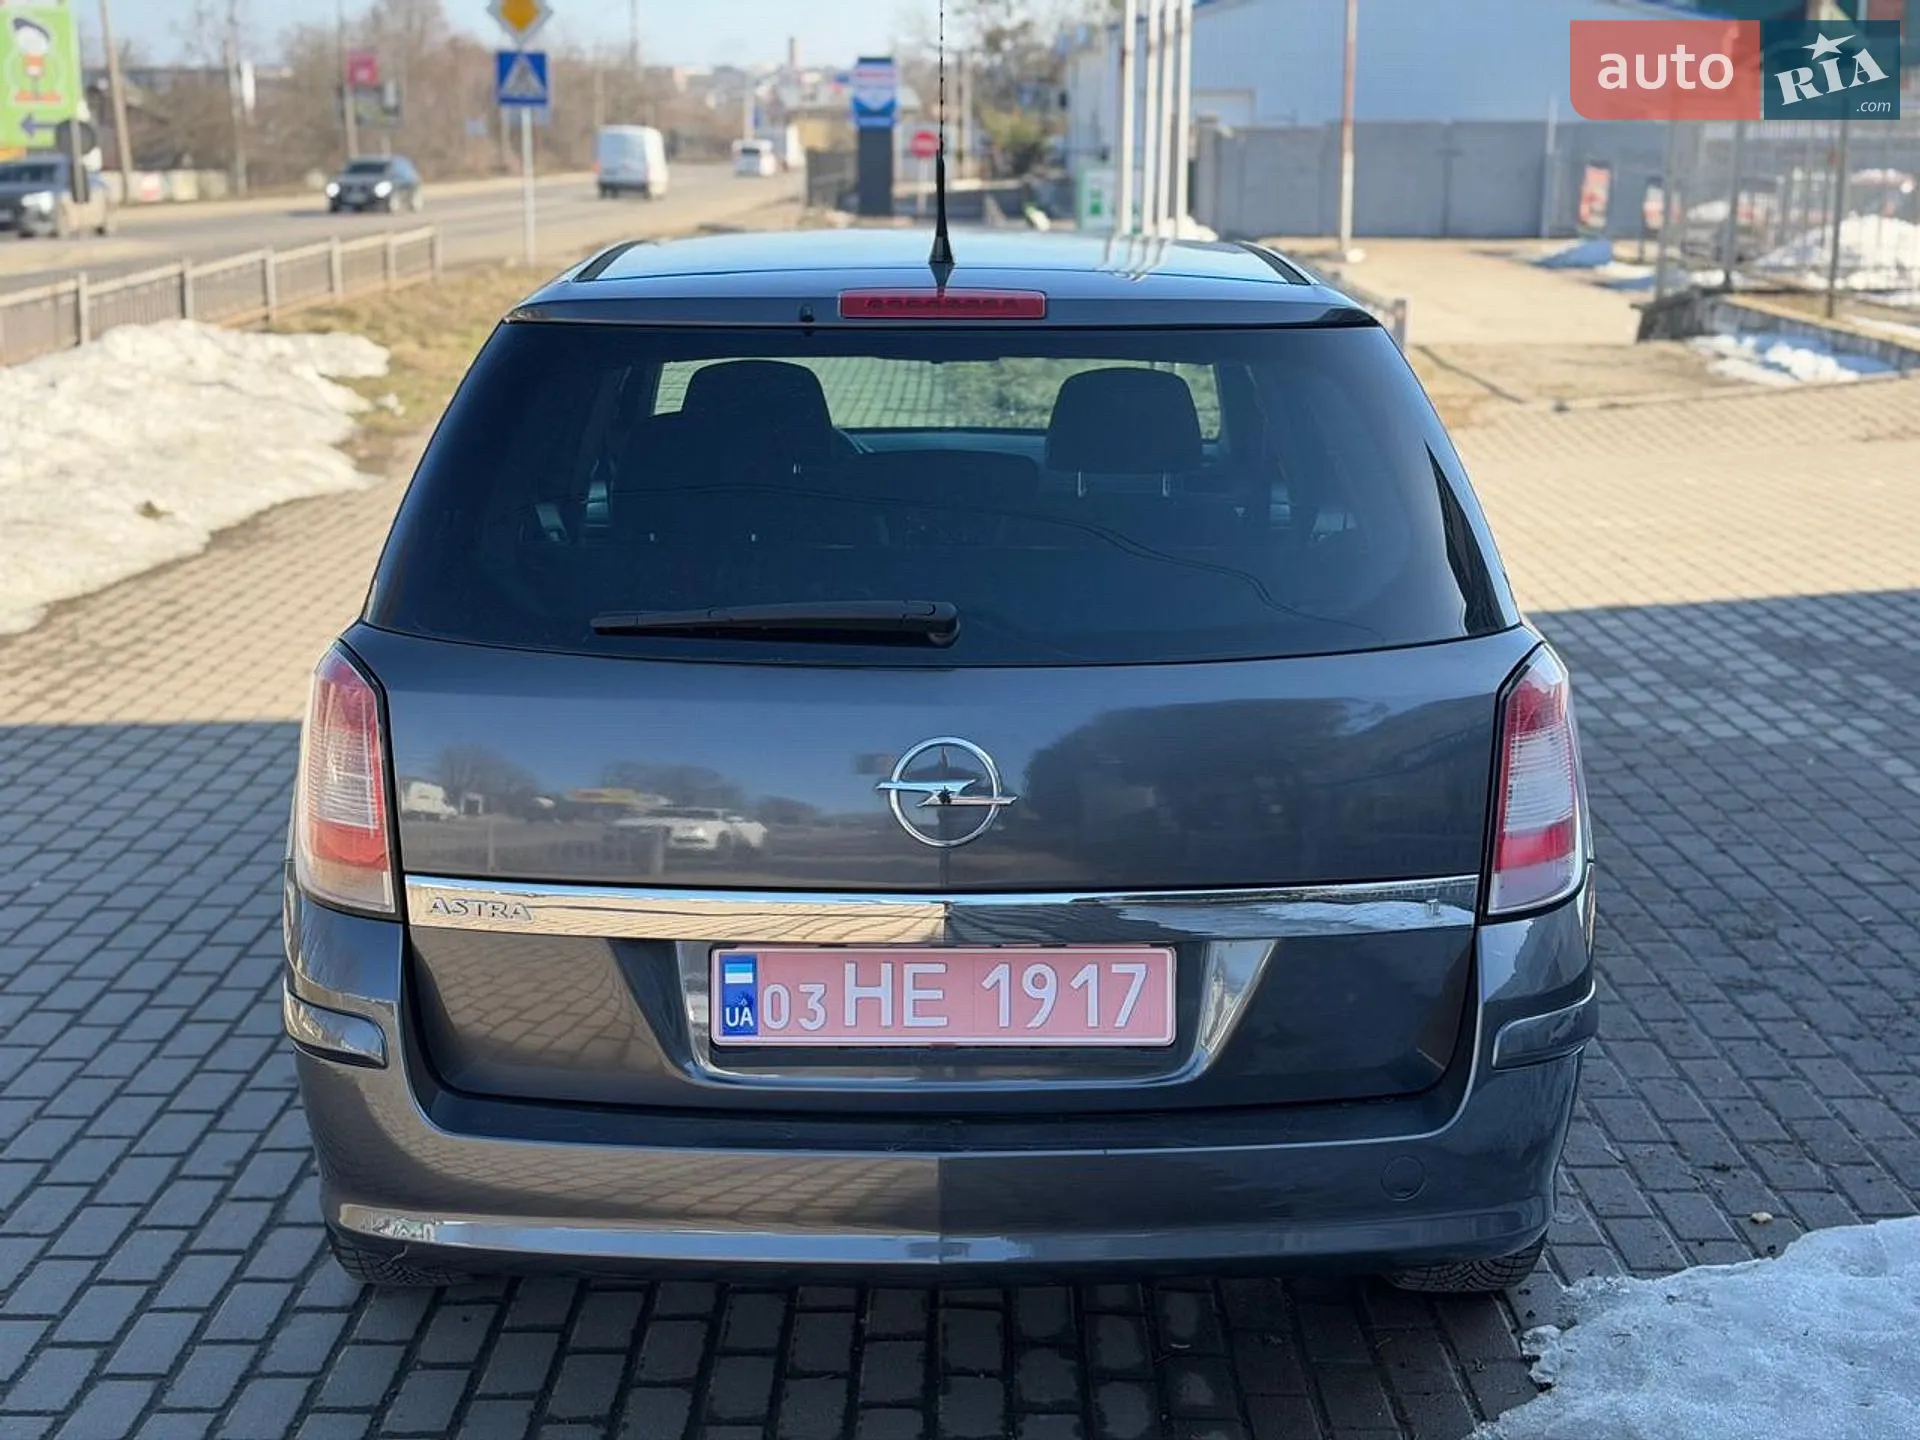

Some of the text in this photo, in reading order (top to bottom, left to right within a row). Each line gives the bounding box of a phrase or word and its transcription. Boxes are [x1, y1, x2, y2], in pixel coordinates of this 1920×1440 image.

[430, 896, 535, 923] ASTRA
[763, 961, 1149, 1031] 03 HE 1917
[725, 1007, 754, 1027] UA
